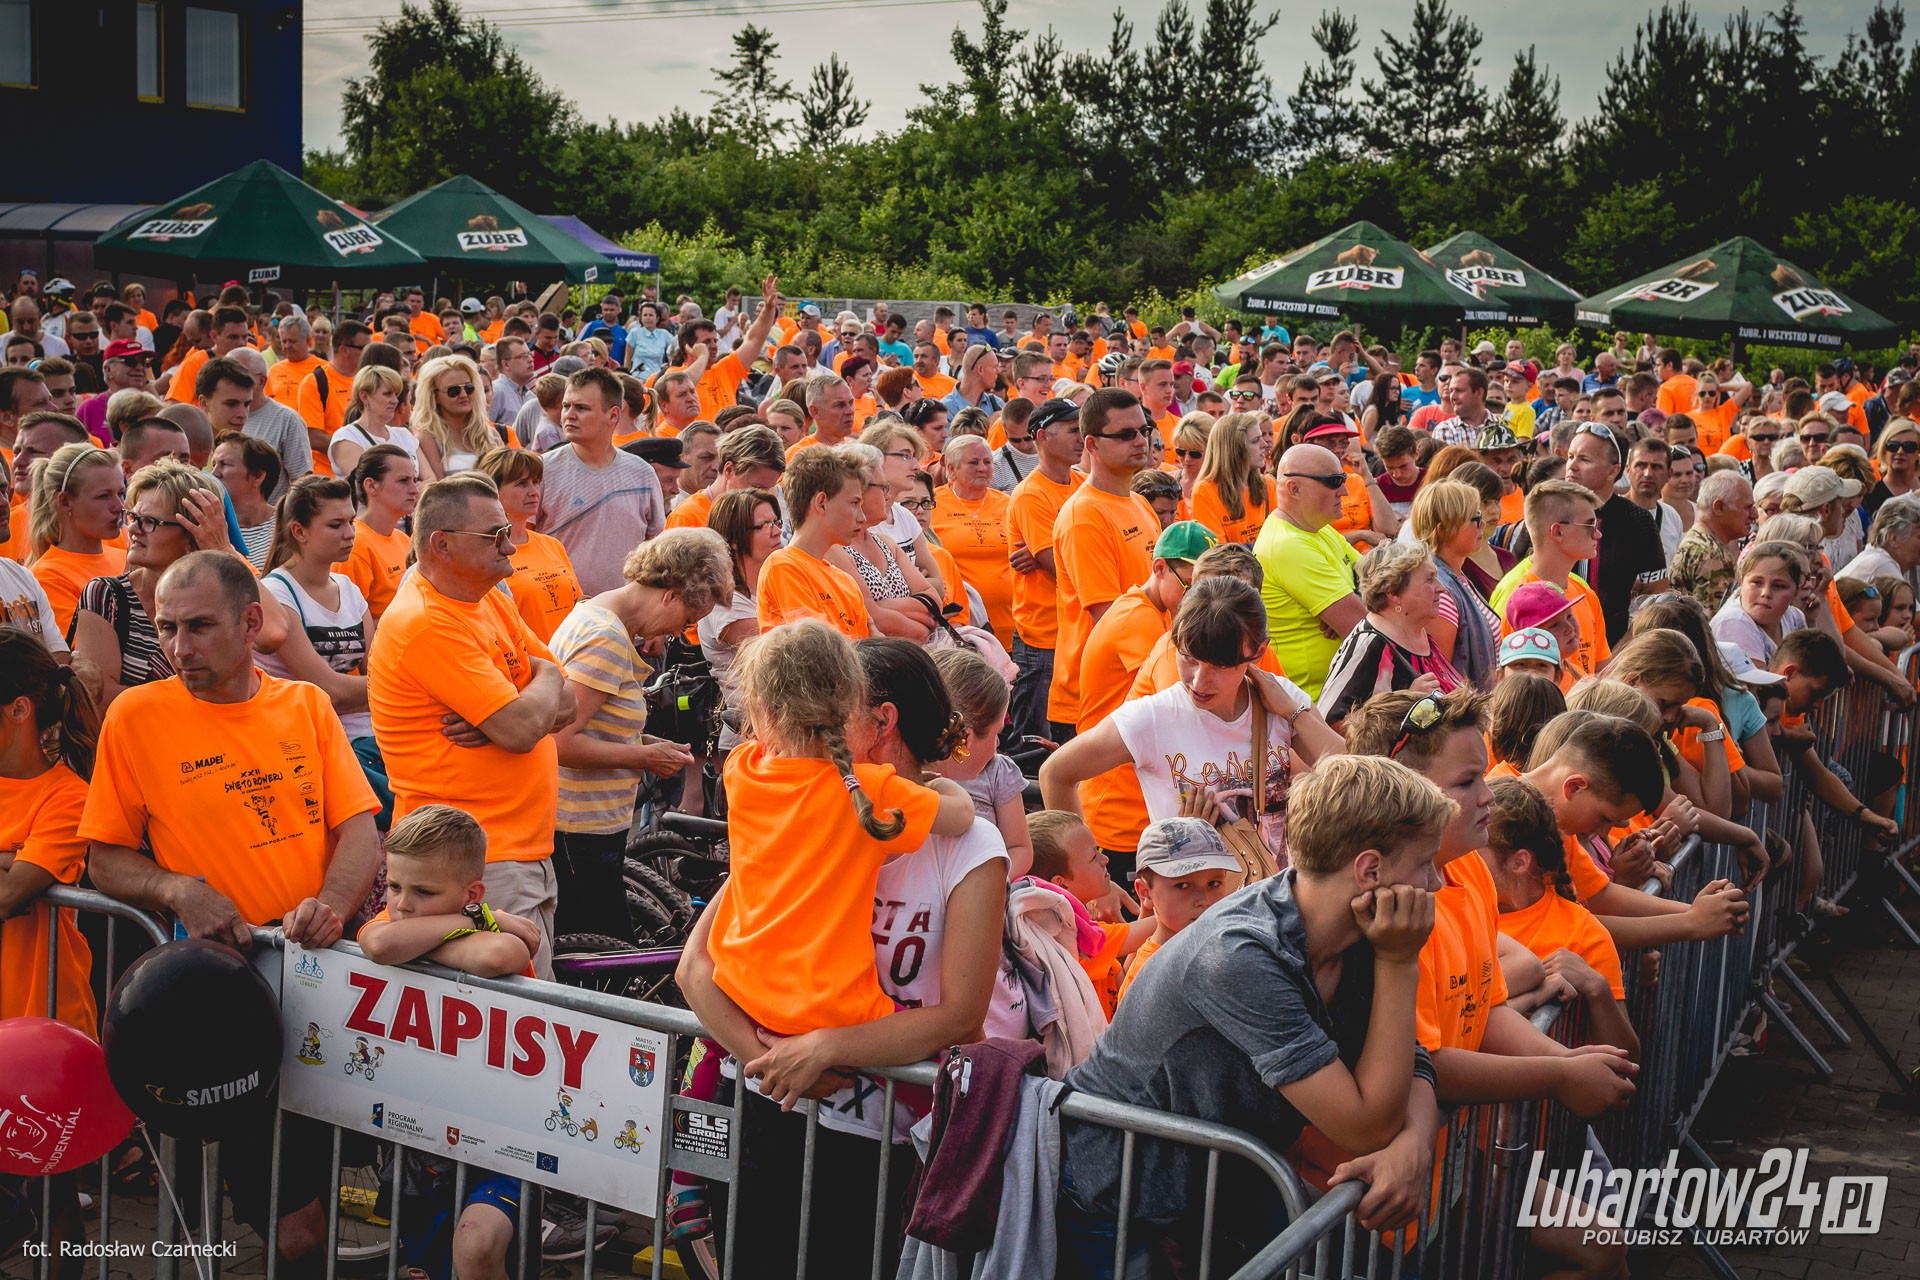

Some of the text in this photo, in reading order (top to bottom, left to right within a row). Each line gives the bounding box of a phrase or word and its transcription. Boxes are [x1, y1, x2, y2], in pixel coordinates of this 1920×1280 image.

[140, 221, 204, 235] ŻUBR
[328, 229, 378, 249] ŻUBR
[463, 233, 522, 246] ŻUBR
[1314, 268, 1396, 287] ŻUBR
[194, 754, 223, 770] MAPEI
[252, 771, 283, 786] ROWERU
[344, 971, 600, 1090] ZAPISY
[635, 1036, 653, 1045] MIASTO
[186, 1070, 259, 1107] SATURN
[387, 1118, 424, 1134] REGIONALNY
[388, 1111, 417, 1125] PROGRAM
[688, 1112, 729, 1133] SLS
[41, 1107, 81, 1173] PRUDENTIAL
[688, 1127, 728, 1140] GROUP
